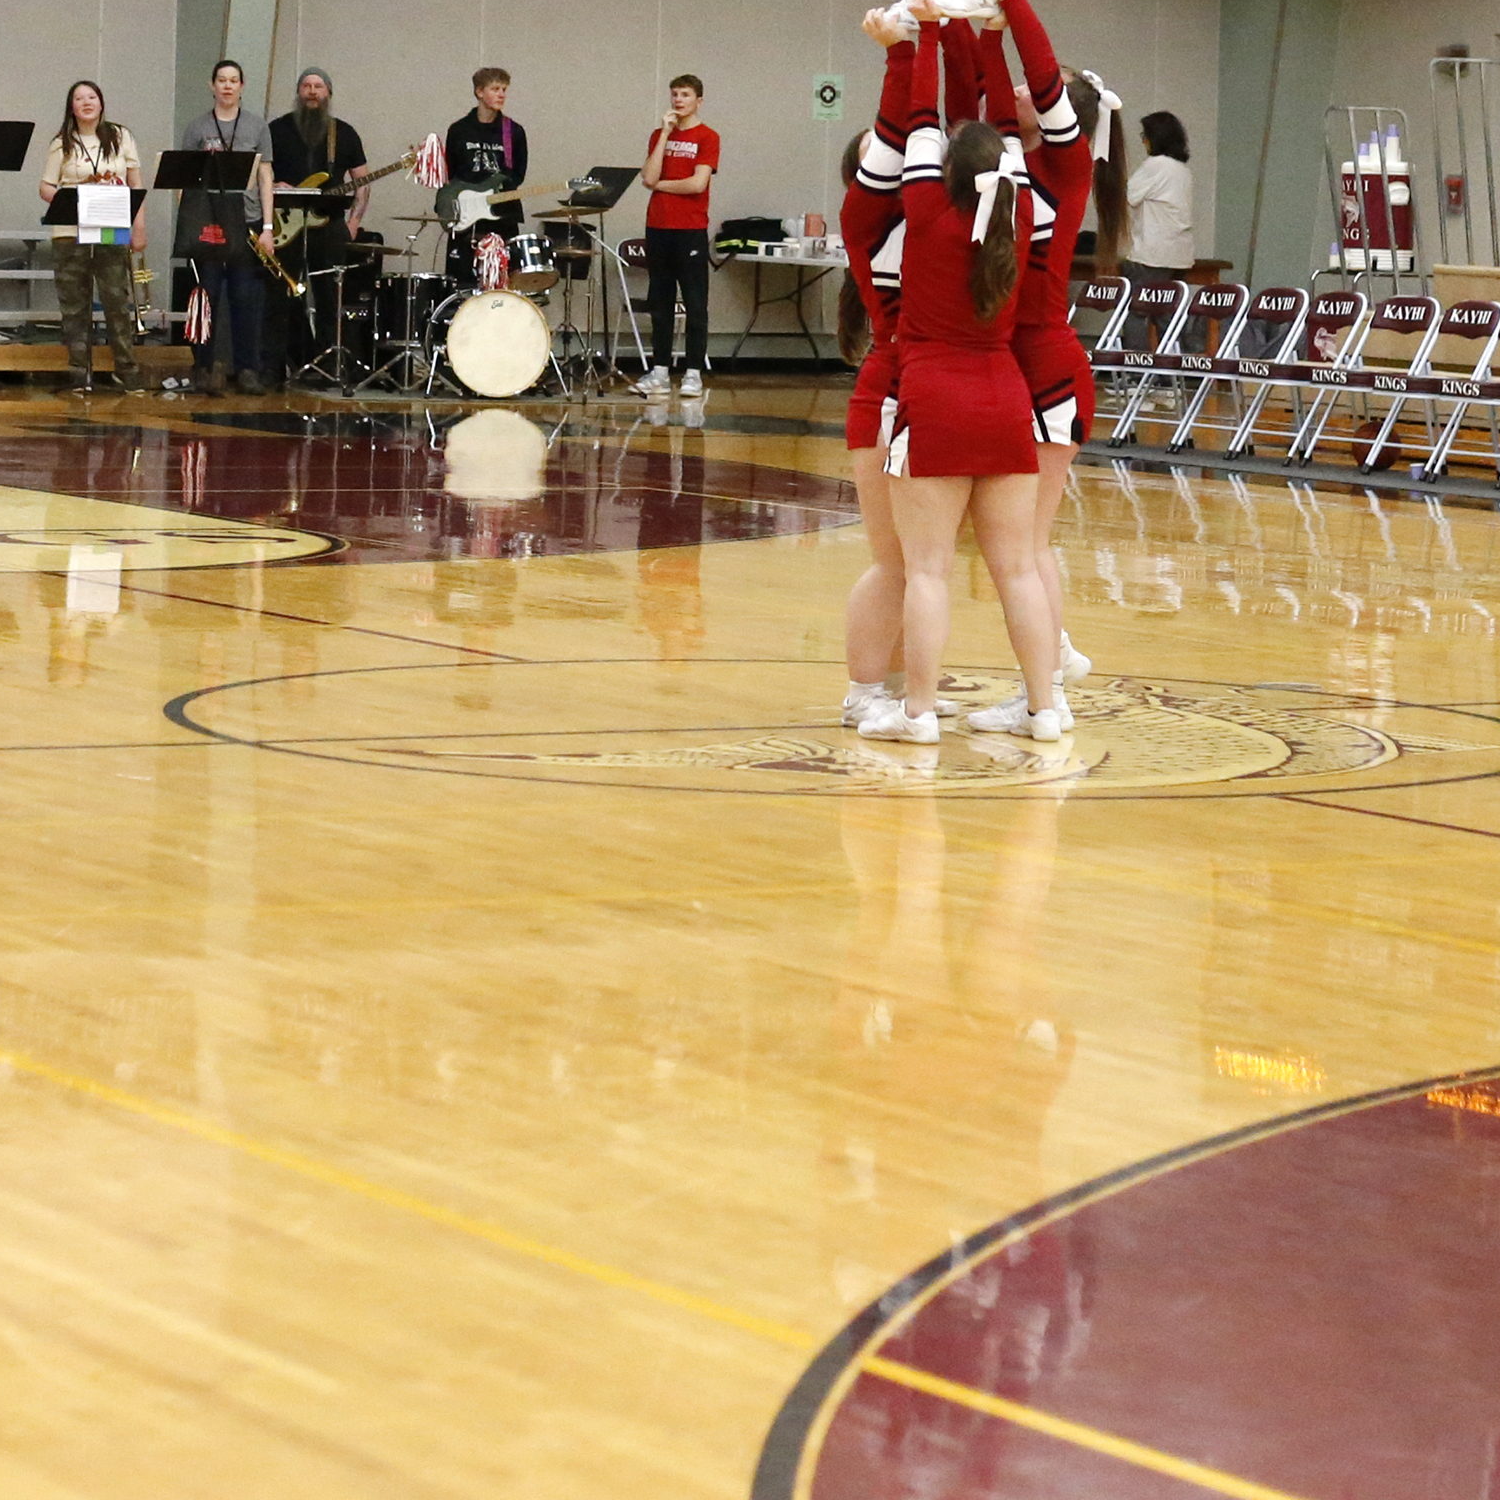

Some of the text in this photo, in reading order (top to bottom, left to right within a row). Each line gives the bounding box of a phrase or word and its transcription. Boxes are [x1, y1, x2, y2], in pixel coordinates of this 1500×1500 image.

[1139, 288, 1175, 302] KAYHI
[1259, 296, 1295, 310] KAYHI
[1383, 304, 1425, 320] KAYHI
[1182, 356, 1211, 369] KINGS
[1313, 367, 1347, 383] KINGS
[1442, 379, 1479, 395] KINGS
